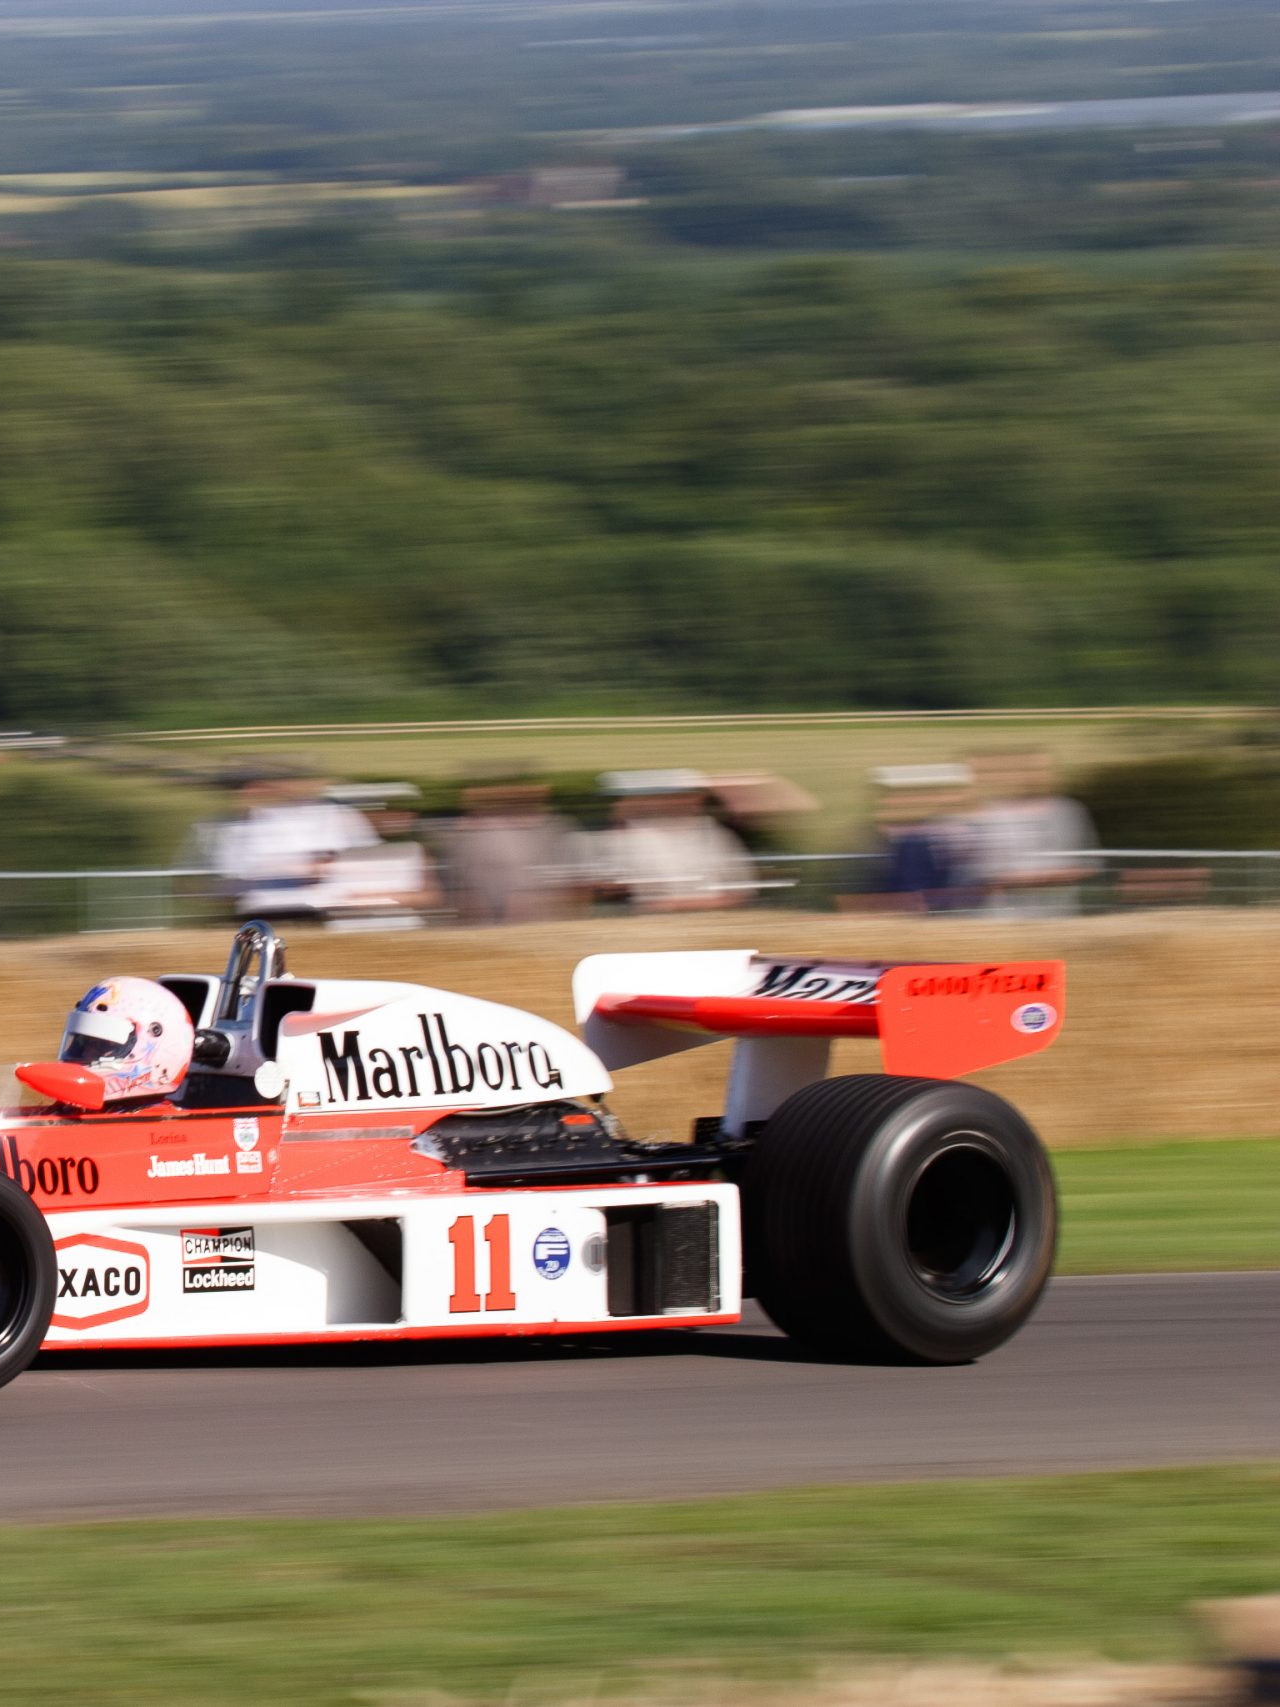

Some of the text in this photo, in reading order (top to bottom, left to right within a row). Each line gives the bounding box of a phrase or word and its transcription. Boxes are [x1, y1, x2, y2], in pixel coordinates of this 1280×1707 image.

[907, 967, 1052, 999] GOODYEAR
[317, 1012, 564, 1104] Marlboro
[147, 1154, 194, 1178] James
[193, 1153, 230, 1176] Hunt
[185, 1236, 251, 1254] CHAMPION
[448, 1213, 516, 1313] 11
[184, 1267, 255, 1289] Lockheed
